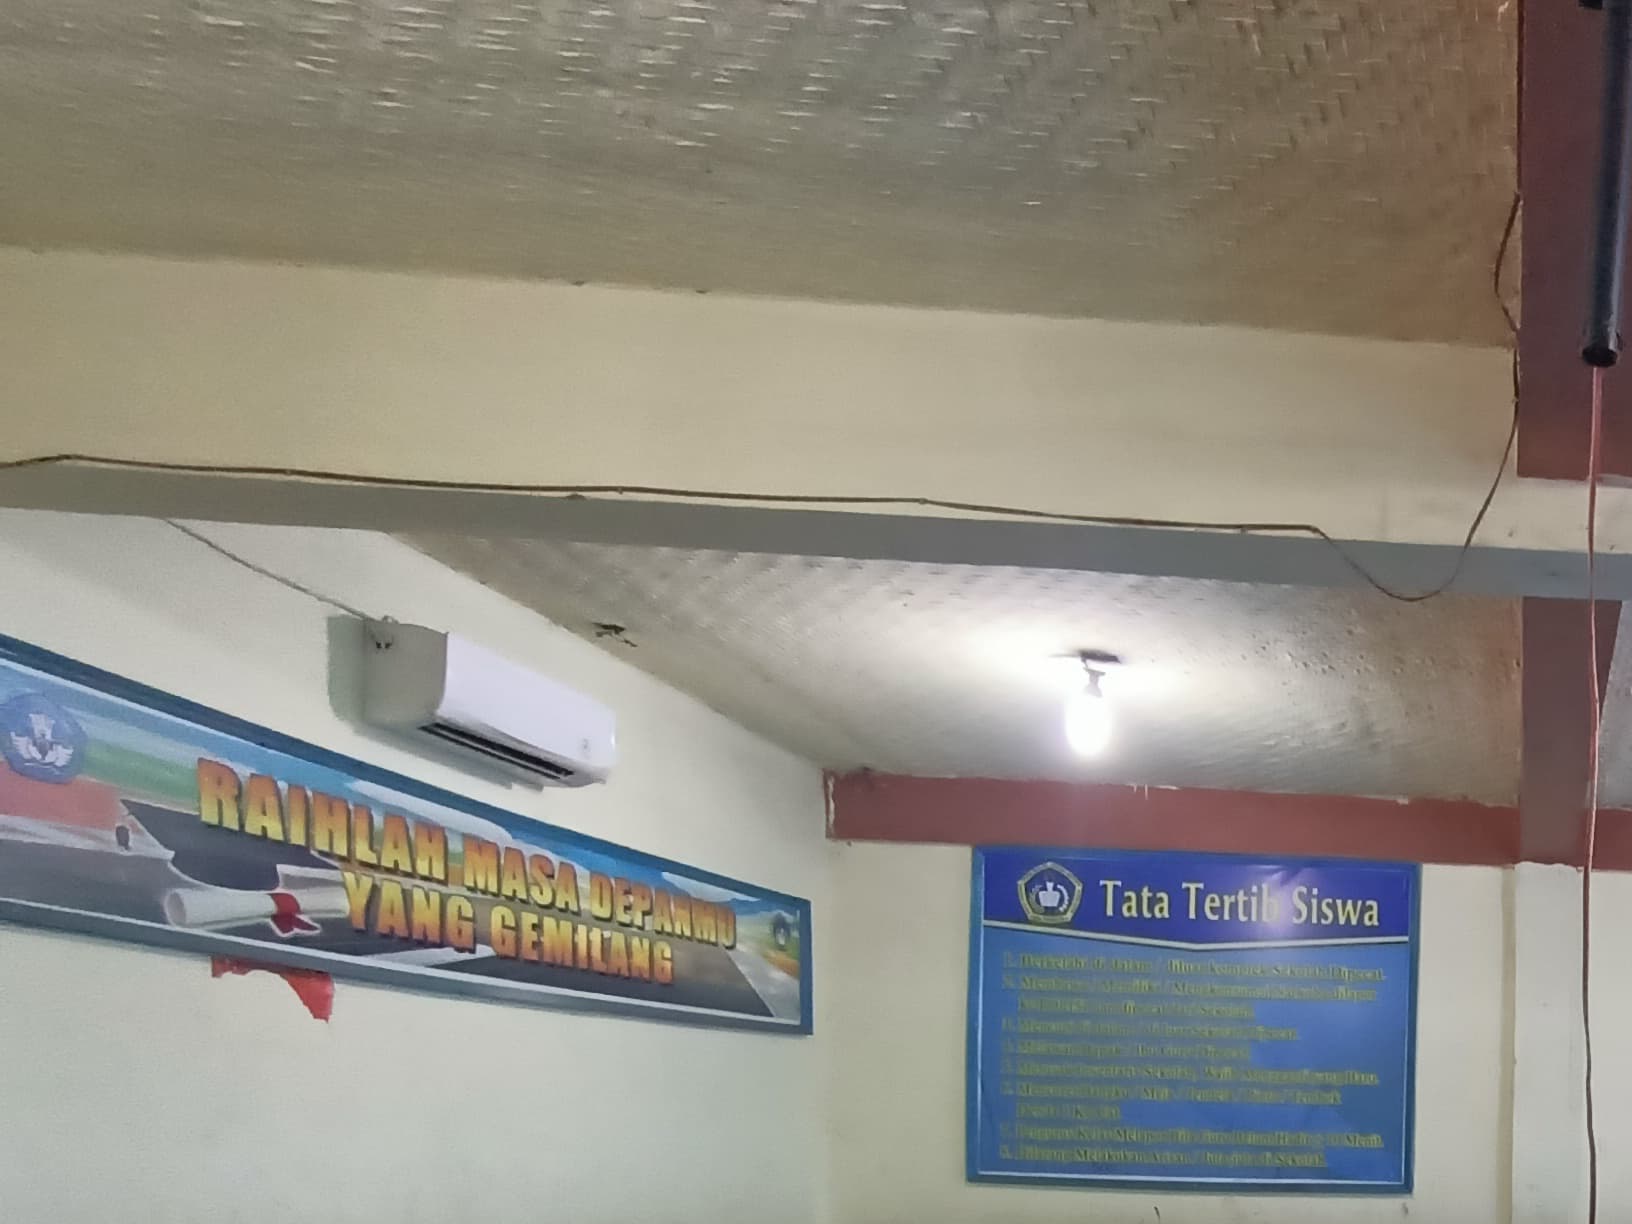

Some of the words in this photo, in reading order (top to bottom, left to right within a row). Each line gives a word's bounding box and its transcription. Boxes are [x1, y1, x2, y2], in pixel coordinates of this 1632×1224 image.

[197, 757, 449, 884] RAIHLAH
[463, 832, 580, 915] MASA
[590, 870, 736, 949] DEPANMU
[342, 871, 476, 953] YANG
[1100, 880, 1170, 918] Tata
[1182, 882, 1280, 922] Tertib
[1292, 885, 1379, 926] Siswa
